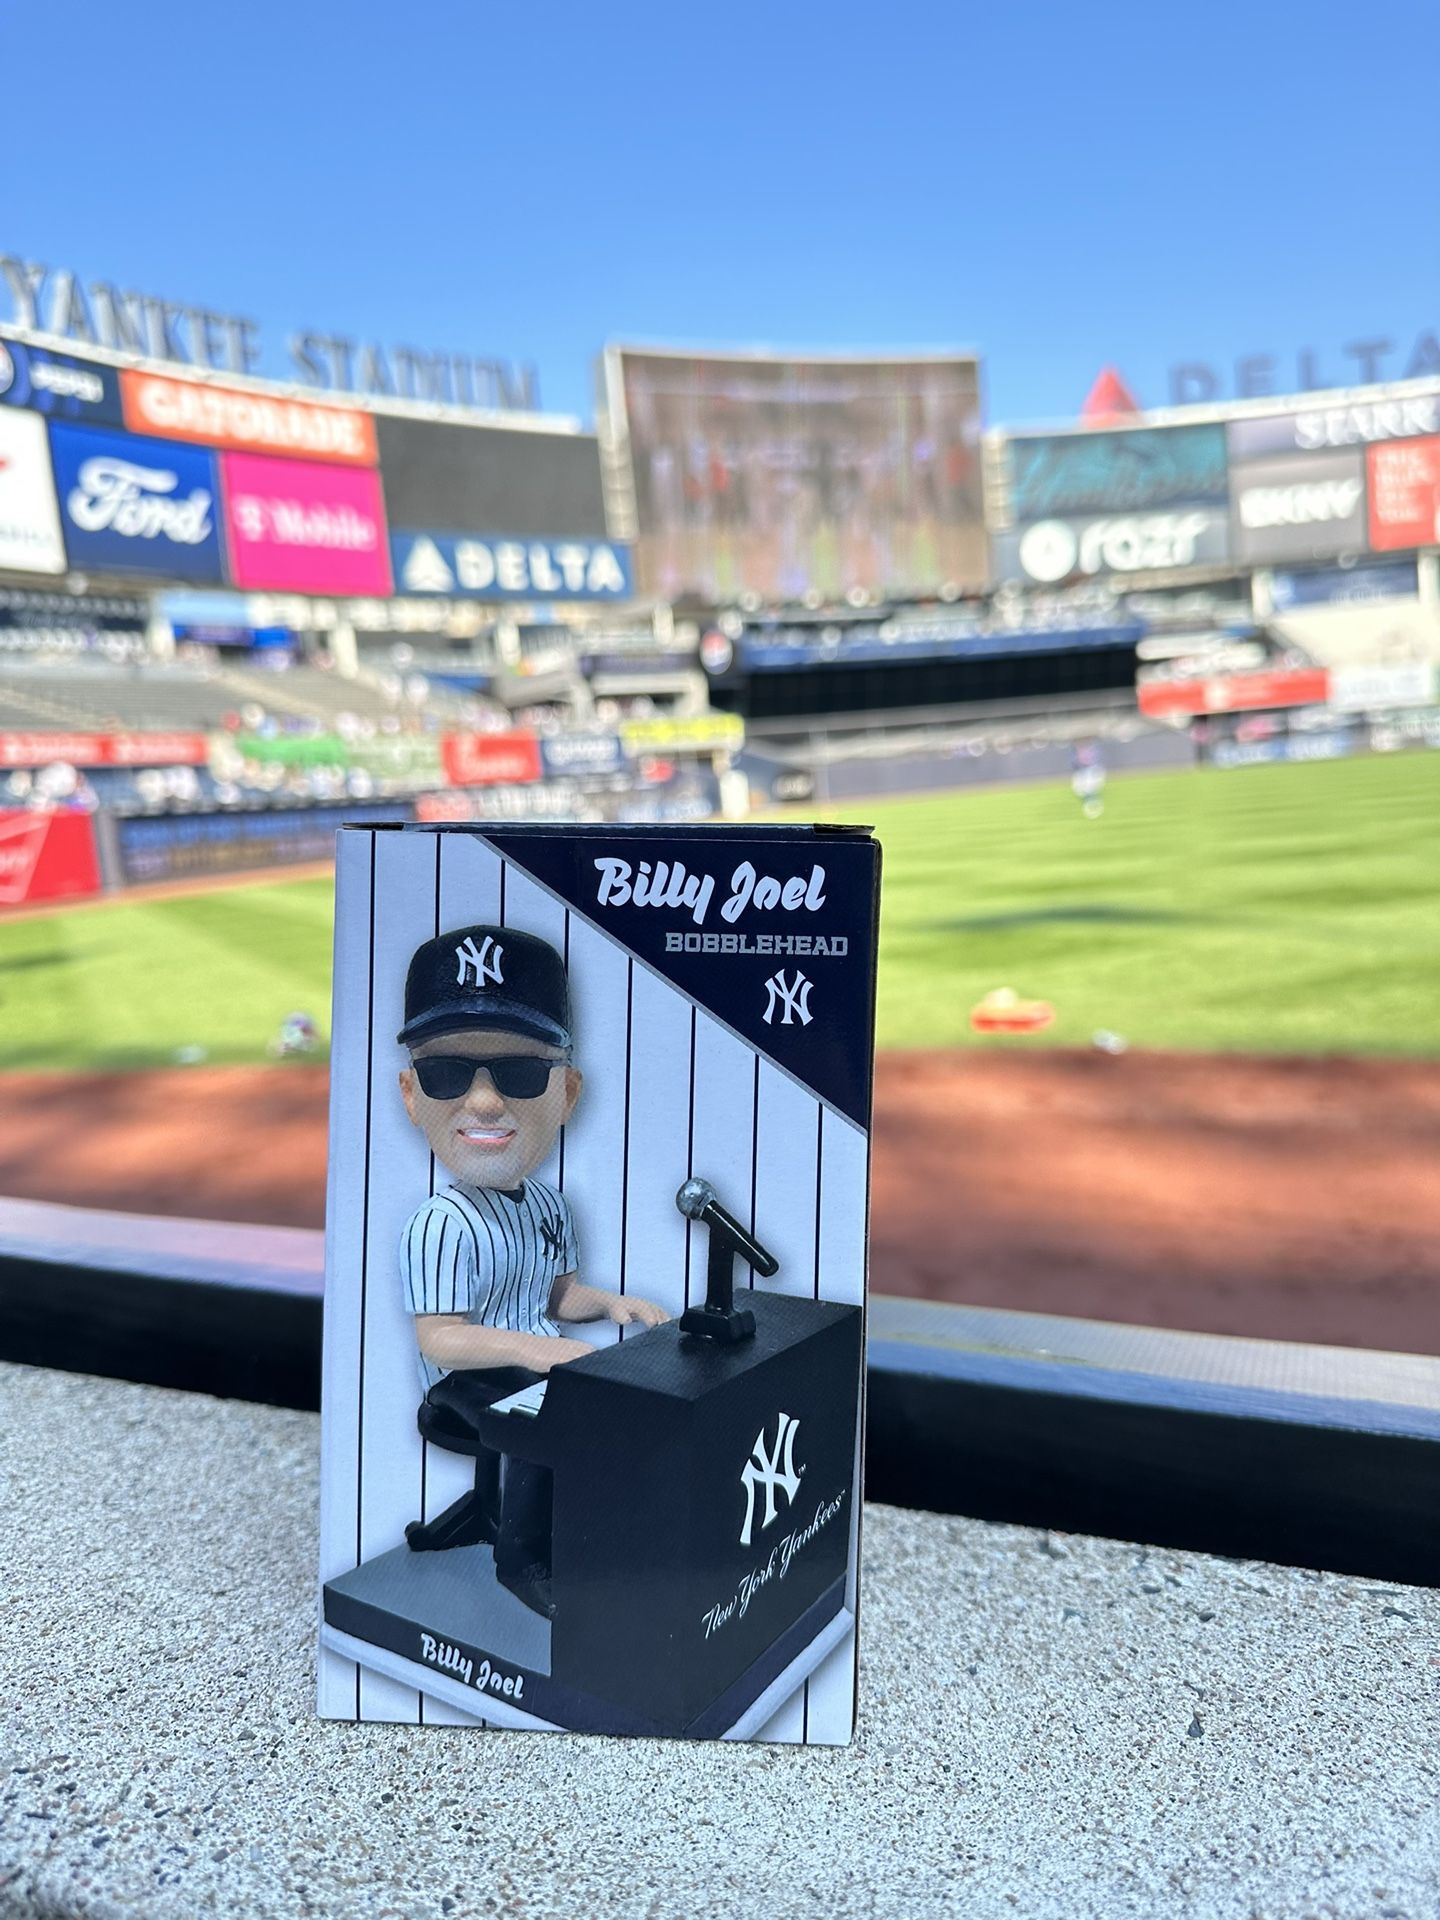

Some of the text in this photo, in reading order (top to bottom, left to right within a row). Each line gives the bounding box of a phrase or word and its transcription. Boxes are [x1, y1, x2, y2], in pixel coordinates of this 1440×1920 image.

[1, 253, 541, 410] YANKEE STADIUM
[1169, 330, 1440, 404] DELTA
[68, 456, 212, 545] Ford
[455, 539, 625, 592] DELTA
[594, 857, 826, 925] Billy Joel
[455, 935, 504, 987] NY
[665, 932, 848, 956] BOBBLEHEAD
[762, 968, 814, 1027] NY
[701, 1595, 739, 1640] New
[738, 1547, 779, 1618] York
[420, 1632, 524, 1699] Billy Joel
